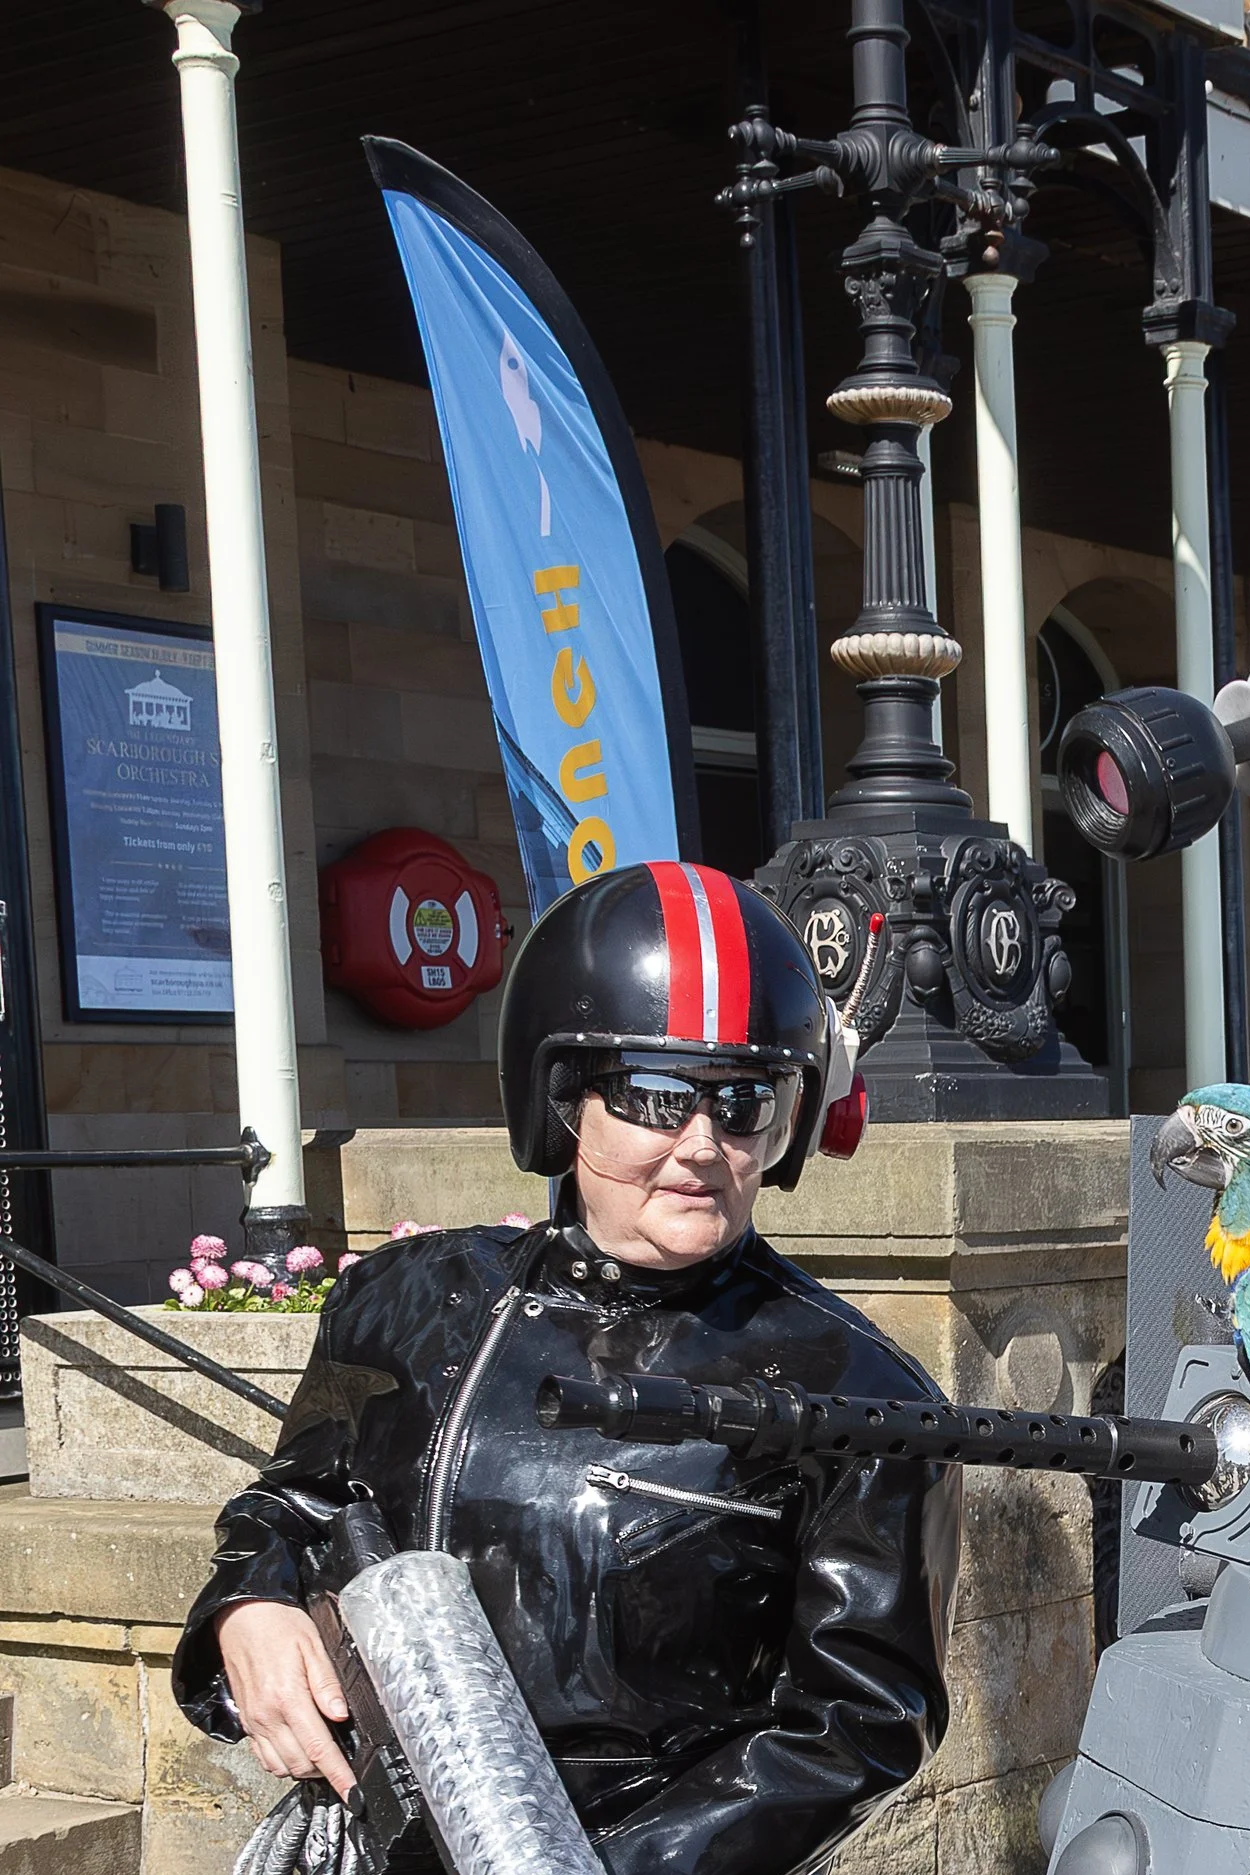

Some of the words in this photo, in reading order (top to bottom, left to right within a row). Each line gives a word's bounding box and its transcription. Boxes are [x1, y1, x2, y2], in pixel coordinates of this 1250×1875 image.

[86, 737, 205, 767] SCARBOROUGH
[117, 762, 211, 788] ORCHESTRA
[123, 836, 156, 849] Tickets
[156, 838, 176, 851] from
[176, 841, 195, 854] only
